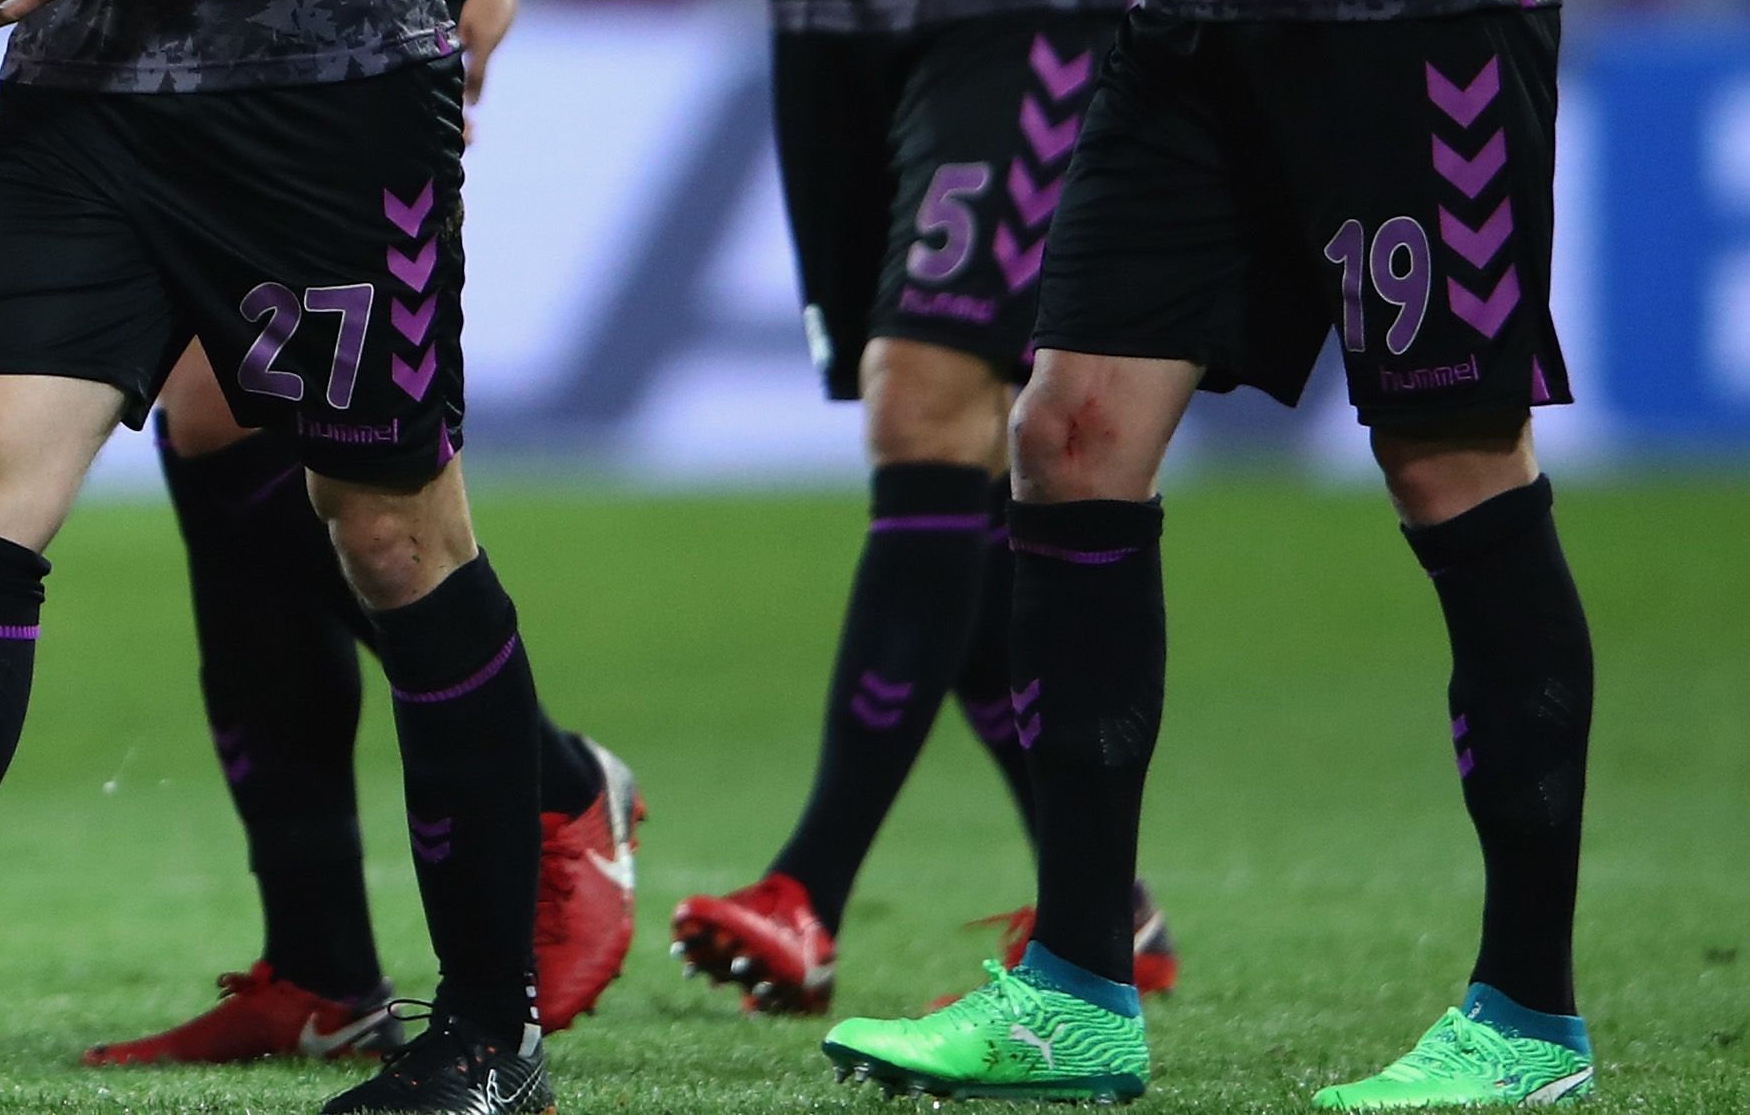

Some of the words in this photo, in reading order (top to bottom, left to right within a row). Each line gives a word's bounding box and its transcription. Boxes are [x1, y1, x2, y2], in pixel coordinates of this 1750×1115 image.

[905, 160, 993, 282] 5
[237, 281, 375, 410] 27
[1323, 215, 1432, 356] 19
[1380, 352, 1480, 391] hummel
